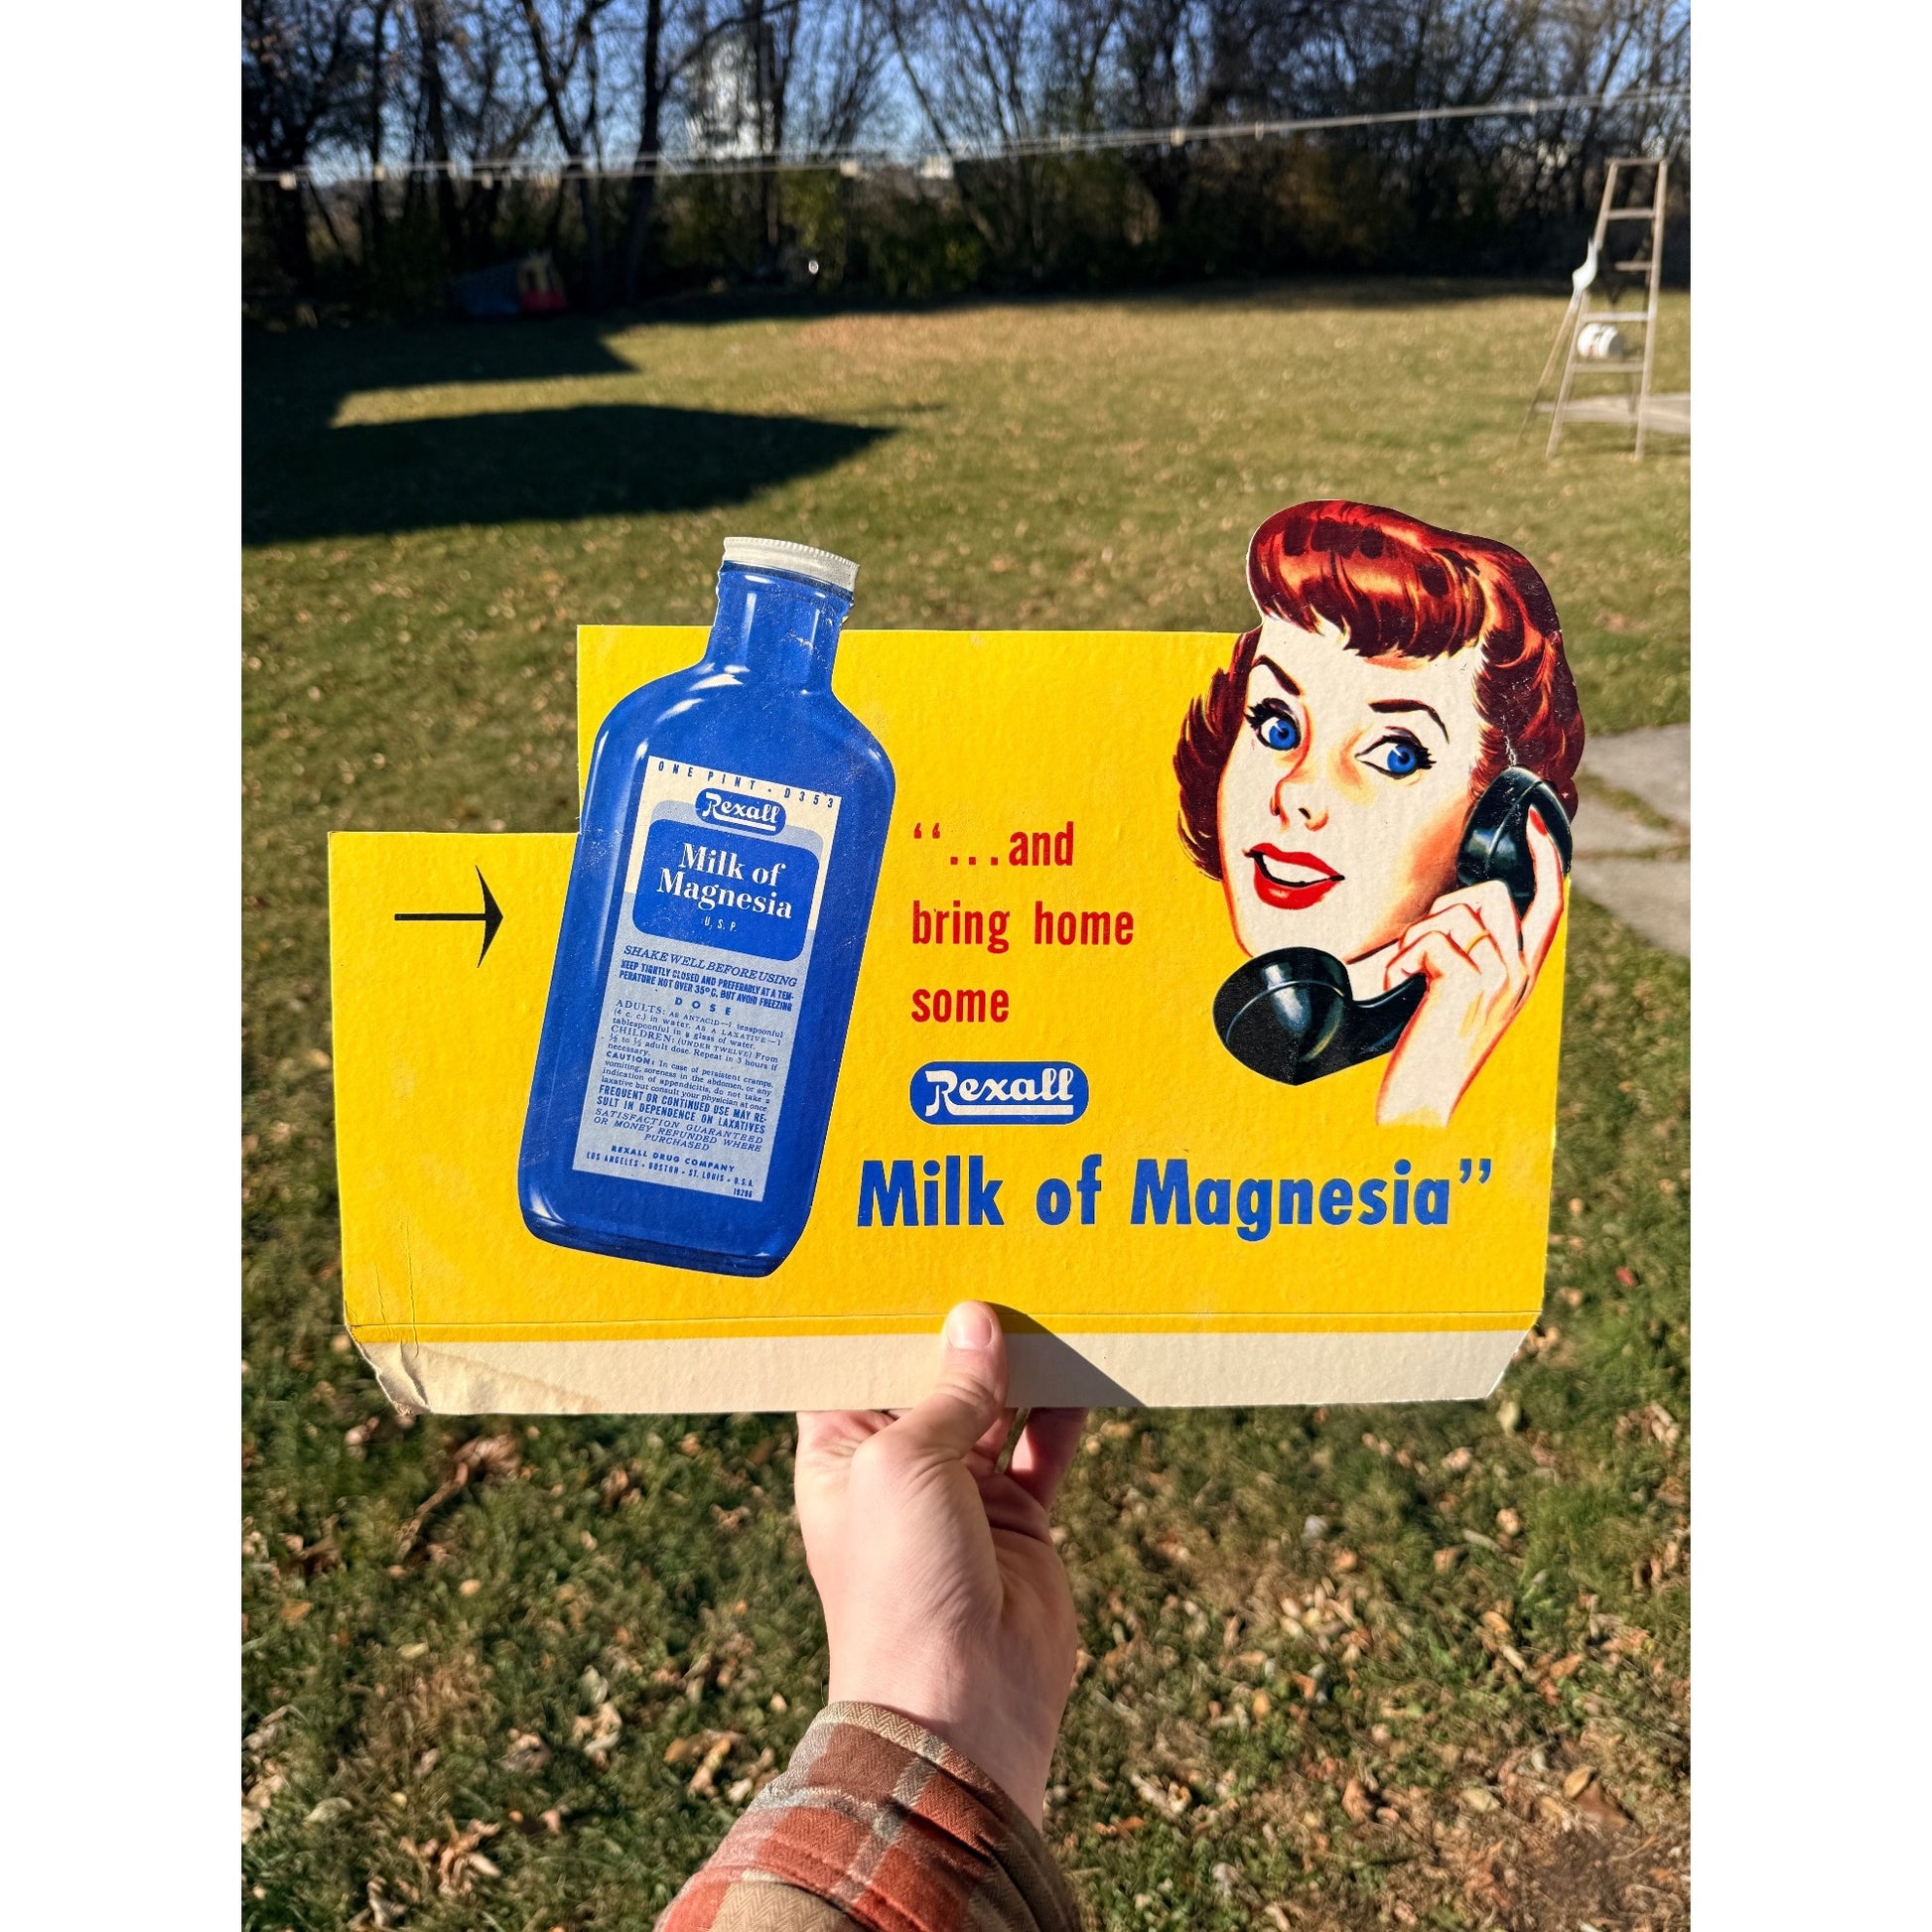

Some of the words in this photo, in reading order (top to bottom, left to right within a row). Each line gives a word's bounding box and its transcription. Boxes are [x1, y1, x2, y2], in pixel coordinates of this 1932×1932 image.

[658, 761, 693, 776] ONE
[708, 771, 756, 789] PINT
[784, 788, 833, 808] D353
[701, 791, 779, 832] Rexall
[679, 843, 745, 879] Milk
[753, 864, 785, 886] of
[657, 868, 791, 918] Magnesia
[911, 900, 1011, 954] bring
[1034, 906, 1135, 945] home
[623, 945, 668, 961] SHAKE
[671, 954, 705, 969] WELL
[706, 962, 758, 979] BEFORE
[759, 972, 797, 987] USING
[641, 963, 670, 977] TIGHTLY
[672, 970, 699, 983] CLOSED
[701, 976, 716, 985] AND
[718, 979, 760, 994] PREFERABLY
[760, 987, 770, 996] AT
[770, 989, 775, 998] A
[620, 970, 656, 984] PERATURE
[657, 978, 673, 988] NOT
[674, 981, 693, 992] OVER
[721, 990, 736, 1000] BUT
[737, 994, 758, 1005] AVOID
[759, 998, 792, 1012] FREEZING
[910, 983, 1011, 1023] some
[614, 1018, 669, 1033] tablespoonful
[693, 1033, 714, 1041] glass
[730, 1040, 755, 1049] water.
[616, 1000, 665, 1015] ADULTS:
[737, 1024, 783, 1037] teaspoonful
[663, 1019, 691, 1029] water.
[608, 1043, 650, 1056] necessary.
[612, 1025, 674, 1042] CHILDREN:
[677, 1038, 710, 1049] (UNDER
[756, 1052, 777, 1063] From
[645, 1041, 667, 1050] adult
[694, 1048, 722, 1060] Repeat
[745, 1058, 767, 1069] hours
[603, 1067, 643, 1080] indication
[607, 1050, 654, 1064] CAUTION:
[702, 1069, 741, 1081] persistent
[644, 1068, 676, 1078] soreness
[599, 1084, 643, 1100] FREQUENT
[646, 1093, 657, 1103] OR
[662, 1095, 710, 1112] CONTINUED
[714, 1105, 730, 1116] USE
[733, 1109, 751, 1120] MAY
[754, 1113, 766, 1123] RE-
[602, 1075, 632, 1087] laxative
[635, 1081, 648, 1090] but
[651, 1086, 679, 1095] consult
[701, 1094, 738, 1106] physician
[924, 1067, 1074, 1116] Rexall
[596, 1108, 680, 1128] SATISFACTION
[686, 1124, 762, 1144] GUARANTEED
[597, 1096, 620, 1107] SULT
[623, 1100, 633, 1110] IN
[639, 1103, 695, 1121] DEPENDENCE
[701, 1114, 713, 1124] ON
[719, 1117, 765, 1134] LAXATIVES
[614, 1120, 653, 1132] MONEY
[658, 1128, 717, 1143] REFUNDED
[724, 1139, 761, 1152] WHERE
[644, 1134, 710, 1151] PURCHASED
[587, 1152, 600, 1161] LOS
[605, 1155, 638, 1167] ANGELES
[649, 1162, 678, 1173] BOSTON
[702, 1172, 724, 1181] LOUIS
[612, 1146, 647, 1157] REXALL
[653, 1153, 679, 1163] DRUG
[685, 1159, 734, 1172] COMPANY
[858, 1155, 1005, 1227] Milk
[1035, 1154, 1102, 1226] of
